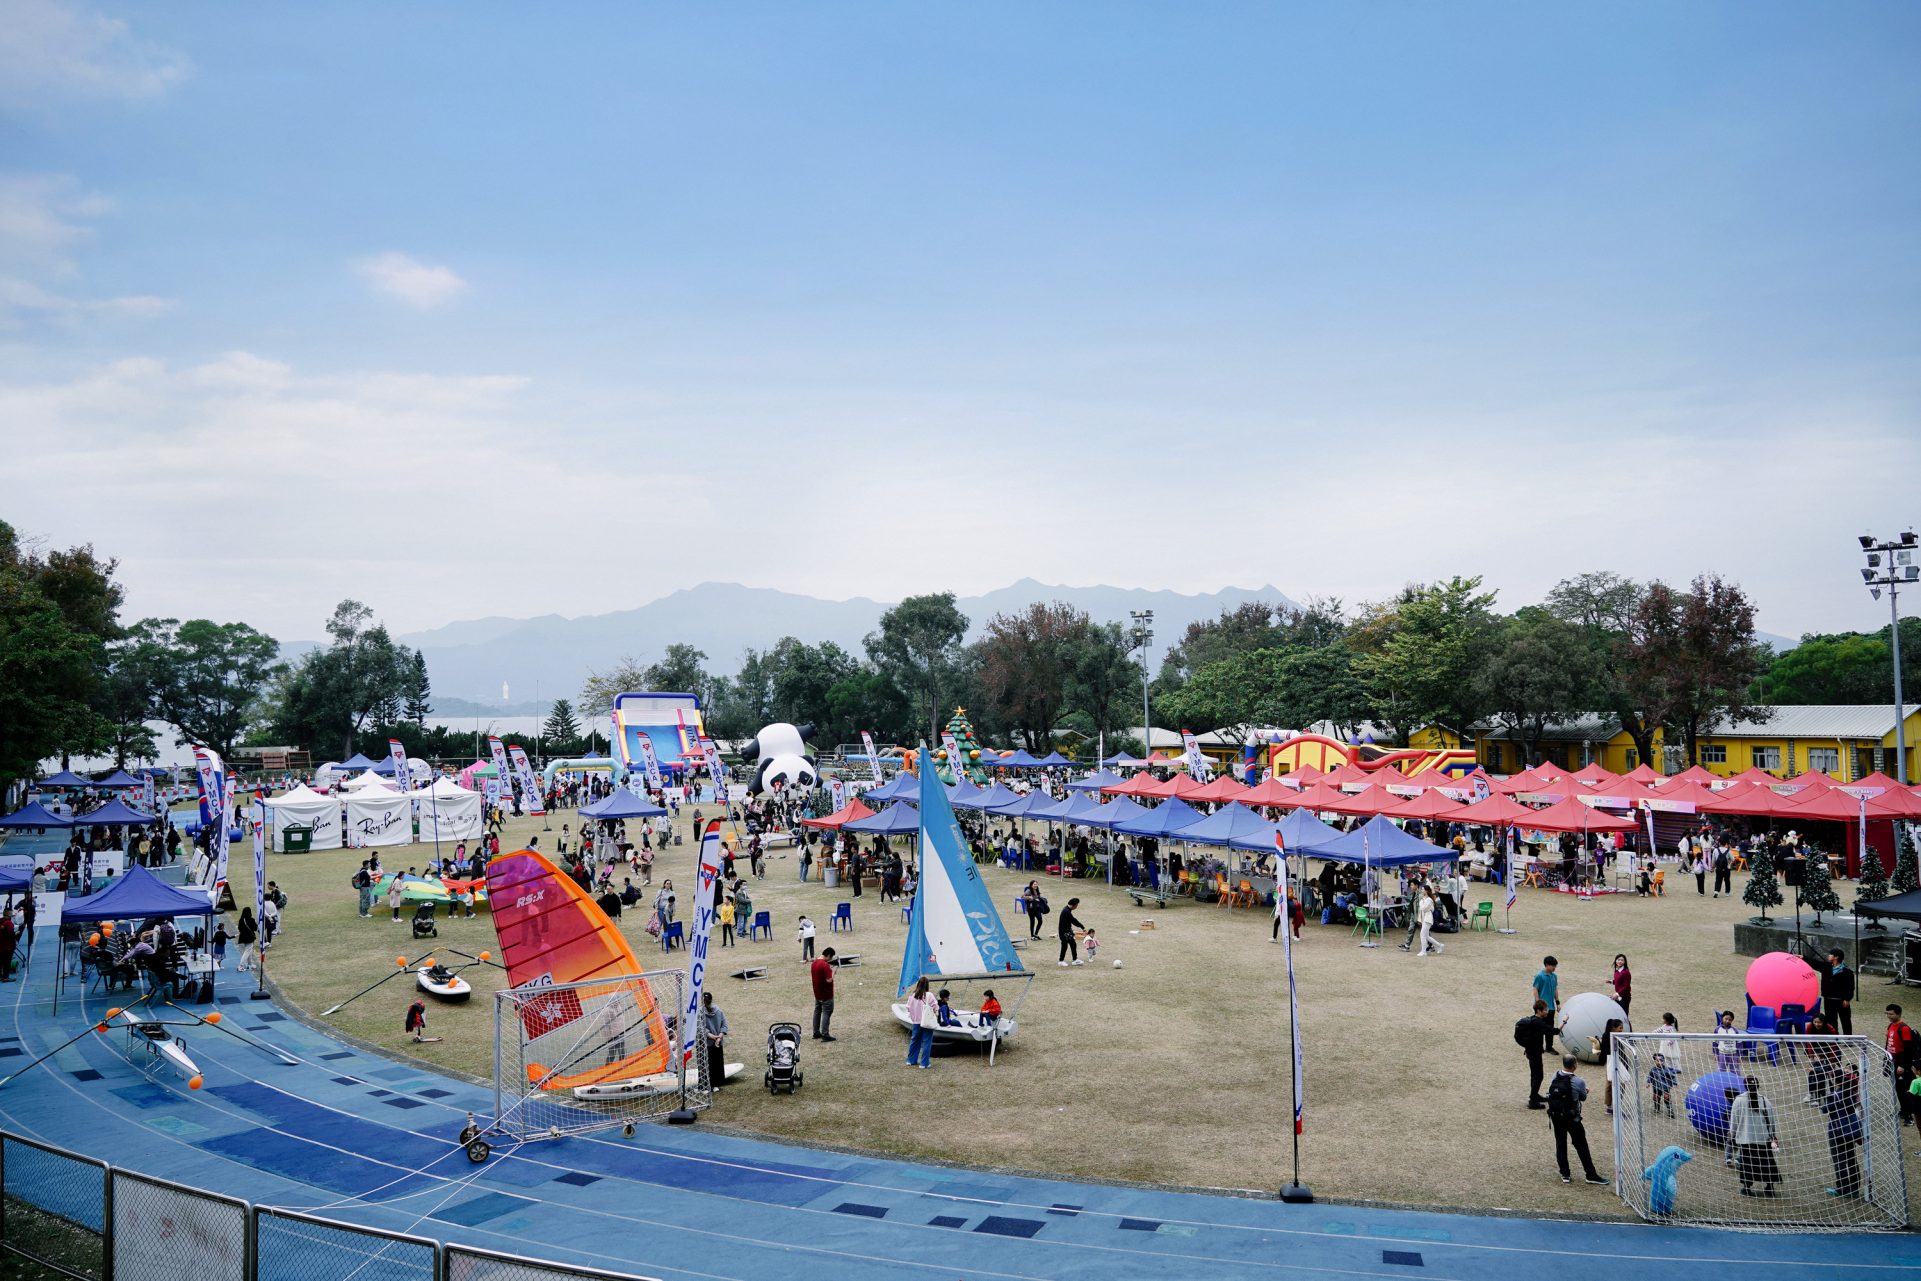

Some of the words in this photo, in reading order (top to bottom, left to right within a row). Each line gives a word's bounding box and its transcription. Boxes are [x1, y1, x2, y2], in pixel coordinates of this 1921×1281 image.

[498, 760, 510, 789] YMCA
[646, 754, 658, 782] YMCA
[710, 761, 726, 792] YMCA
[869, 750, 880, 775] YMCA
[397, 763, 408, 791] YMCA
[522, 770, 538, 804] YMCA
[207, 781, 220, 816] YMCA
[835, 796, 843, 812] YMC
[357, 811, 402, 835] Ray-Ban
[256, 852, 265, 923] YMCA
[516, 889, 545, 908] RS:X
[966, 902, 1007, 966] Pico
[687, 906, 712, 1015] YMCA
[524, 975, 552, 988] KG
